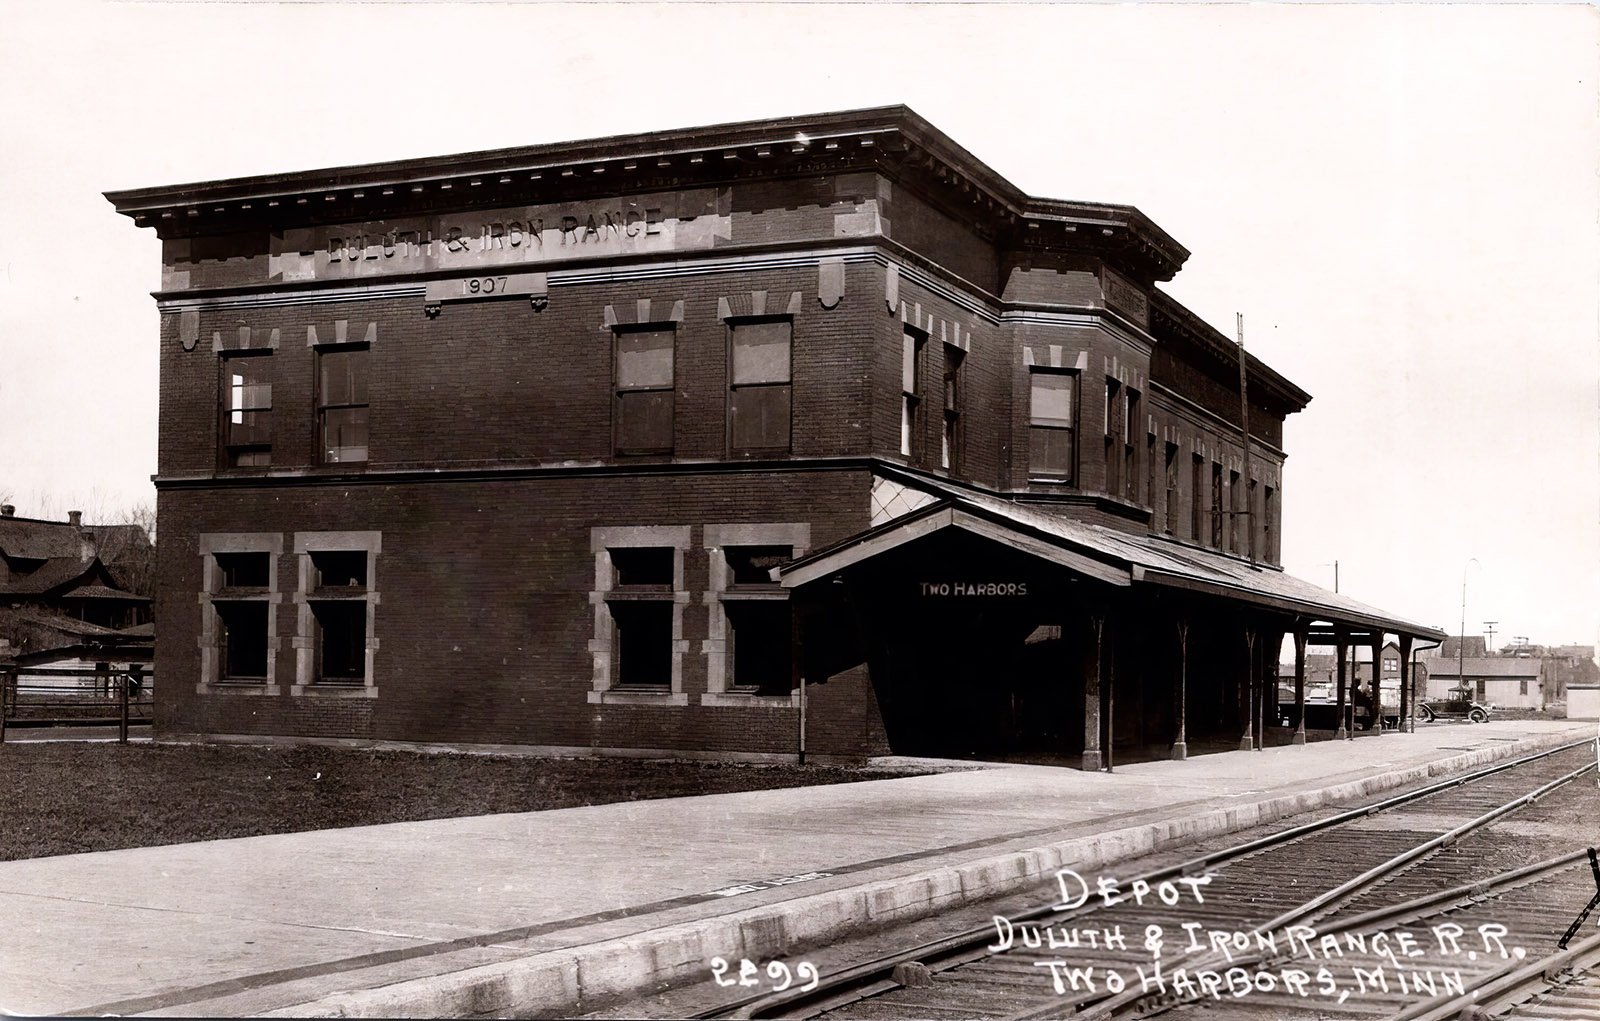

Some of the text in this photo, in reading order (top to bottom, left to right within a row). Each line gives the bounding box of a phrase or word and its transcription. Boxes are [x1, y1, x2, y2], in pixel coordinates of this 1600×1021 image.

[327, 207, 661, 263] DULUTH & IRON RANGE
[462, 276, 508, 295] 1907
[920, 582, 1028, 596] TWO HARBORS
